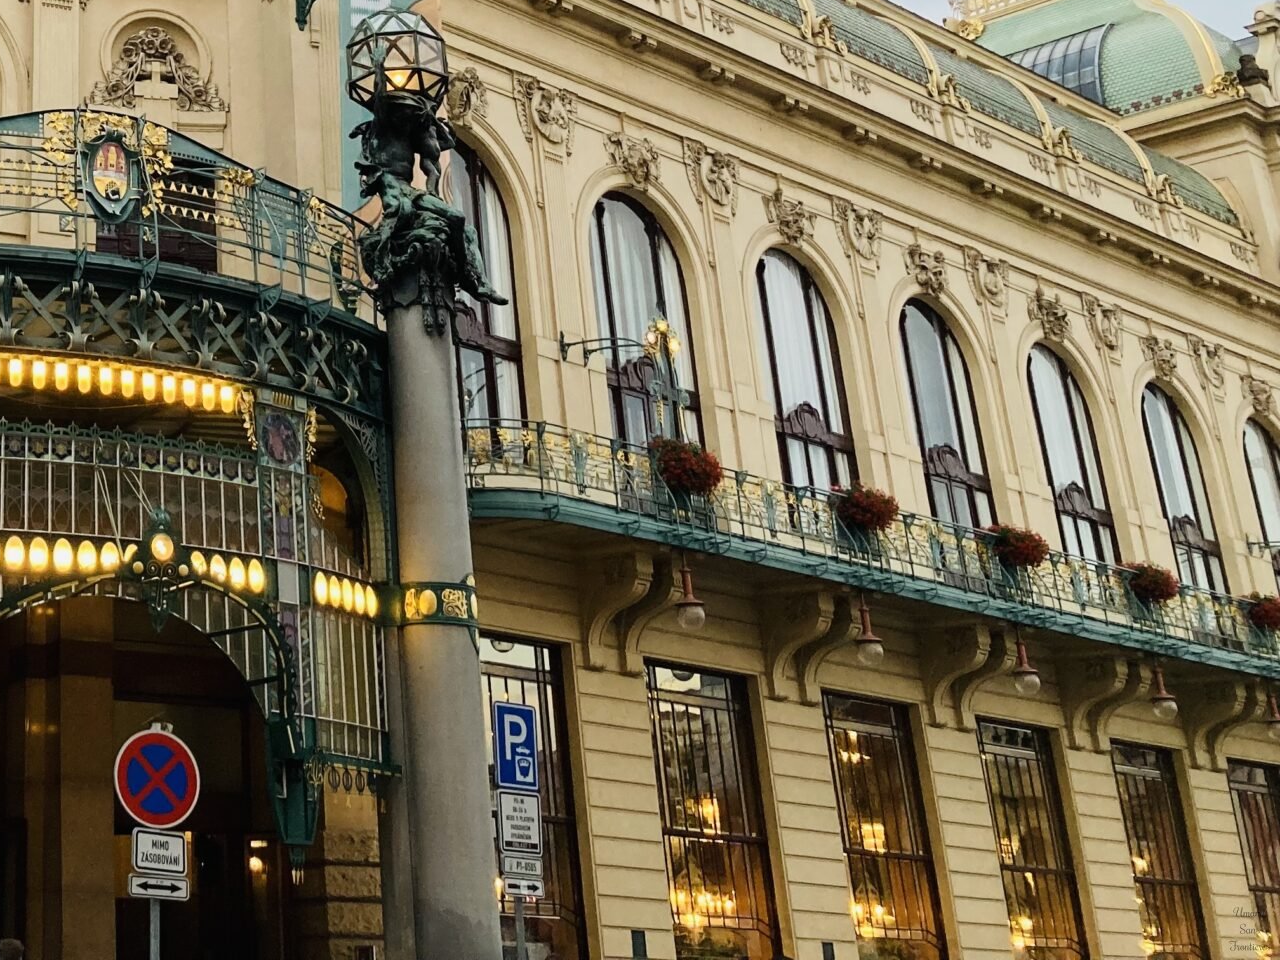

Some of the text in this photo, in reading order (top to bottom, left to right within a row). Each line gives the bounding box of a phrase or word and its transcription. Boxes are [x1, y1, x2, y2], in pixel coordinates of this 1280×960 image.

[503, 713, 528, 761] P
[151, 839, 169, 851] MIMO
[141, 850, 180, 867] ZÁSOBOVÁNÍ
